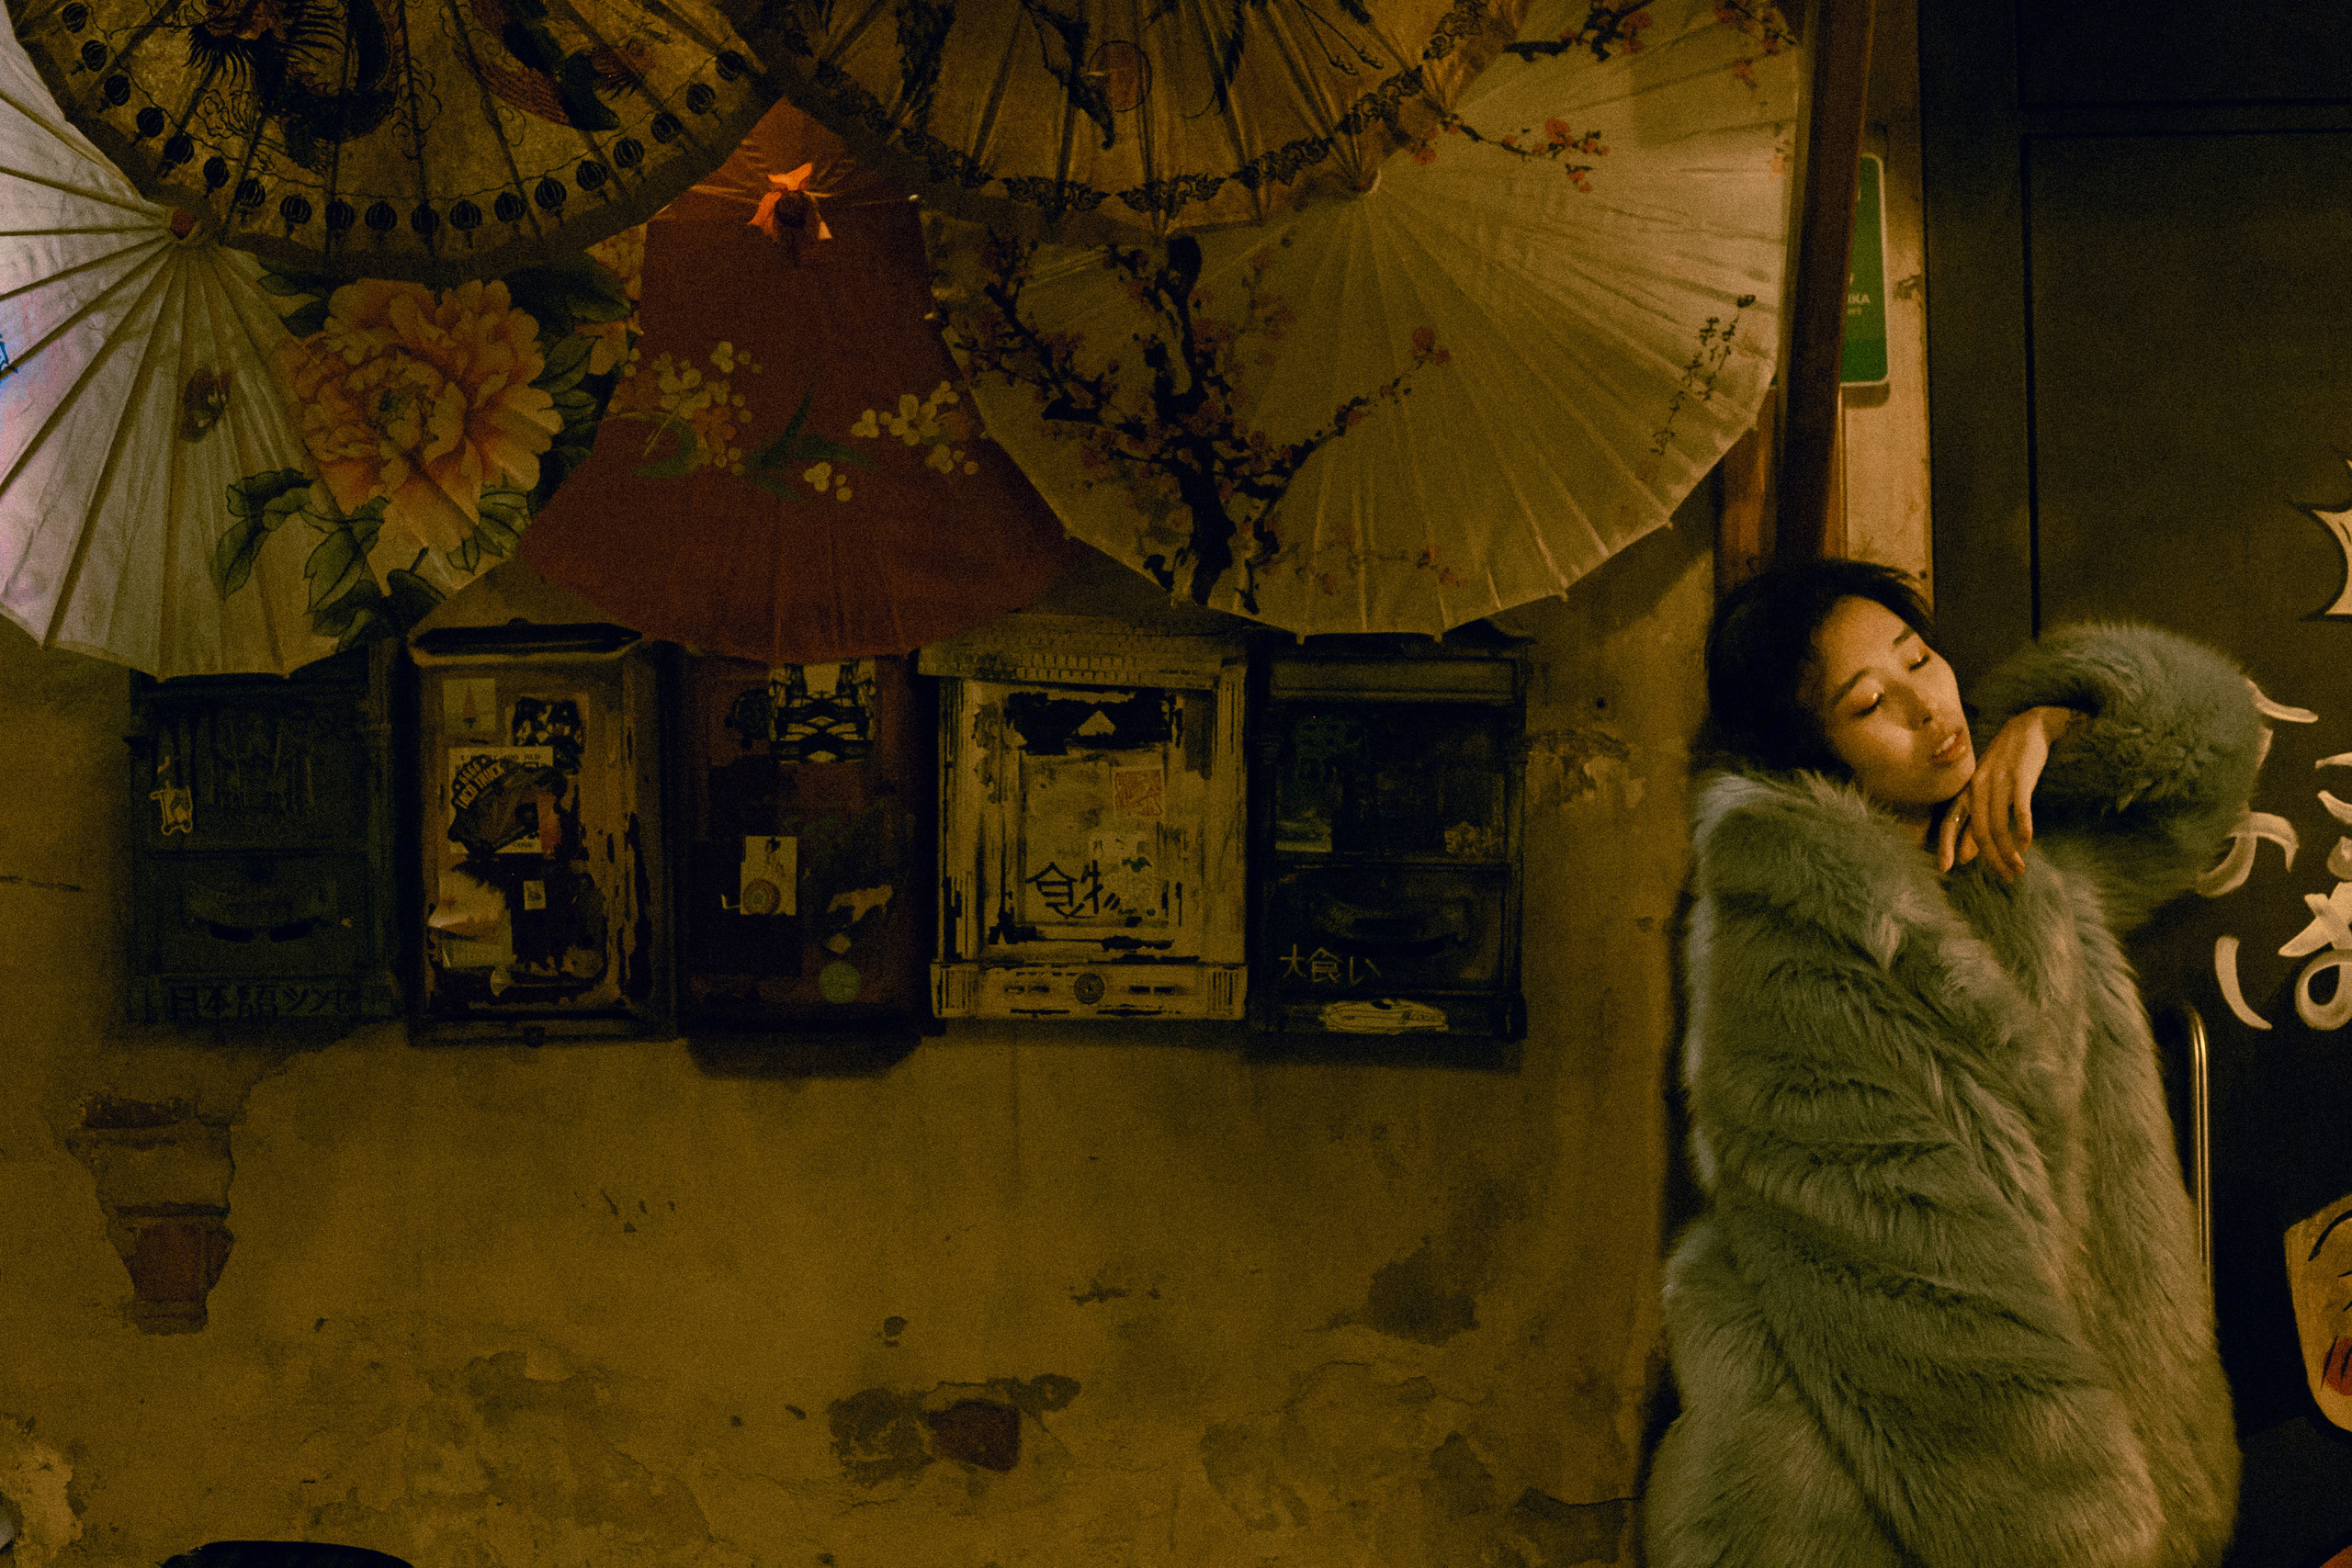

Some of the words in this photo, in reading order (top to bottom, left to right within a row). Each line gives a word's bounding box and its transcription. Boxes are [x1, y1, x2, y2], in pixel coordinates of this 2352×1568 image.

[454, 782, 480, 809] TACO
[474, 761, 505, 790] TRUCK
[1278, 942, 1383, 987] 大食い
